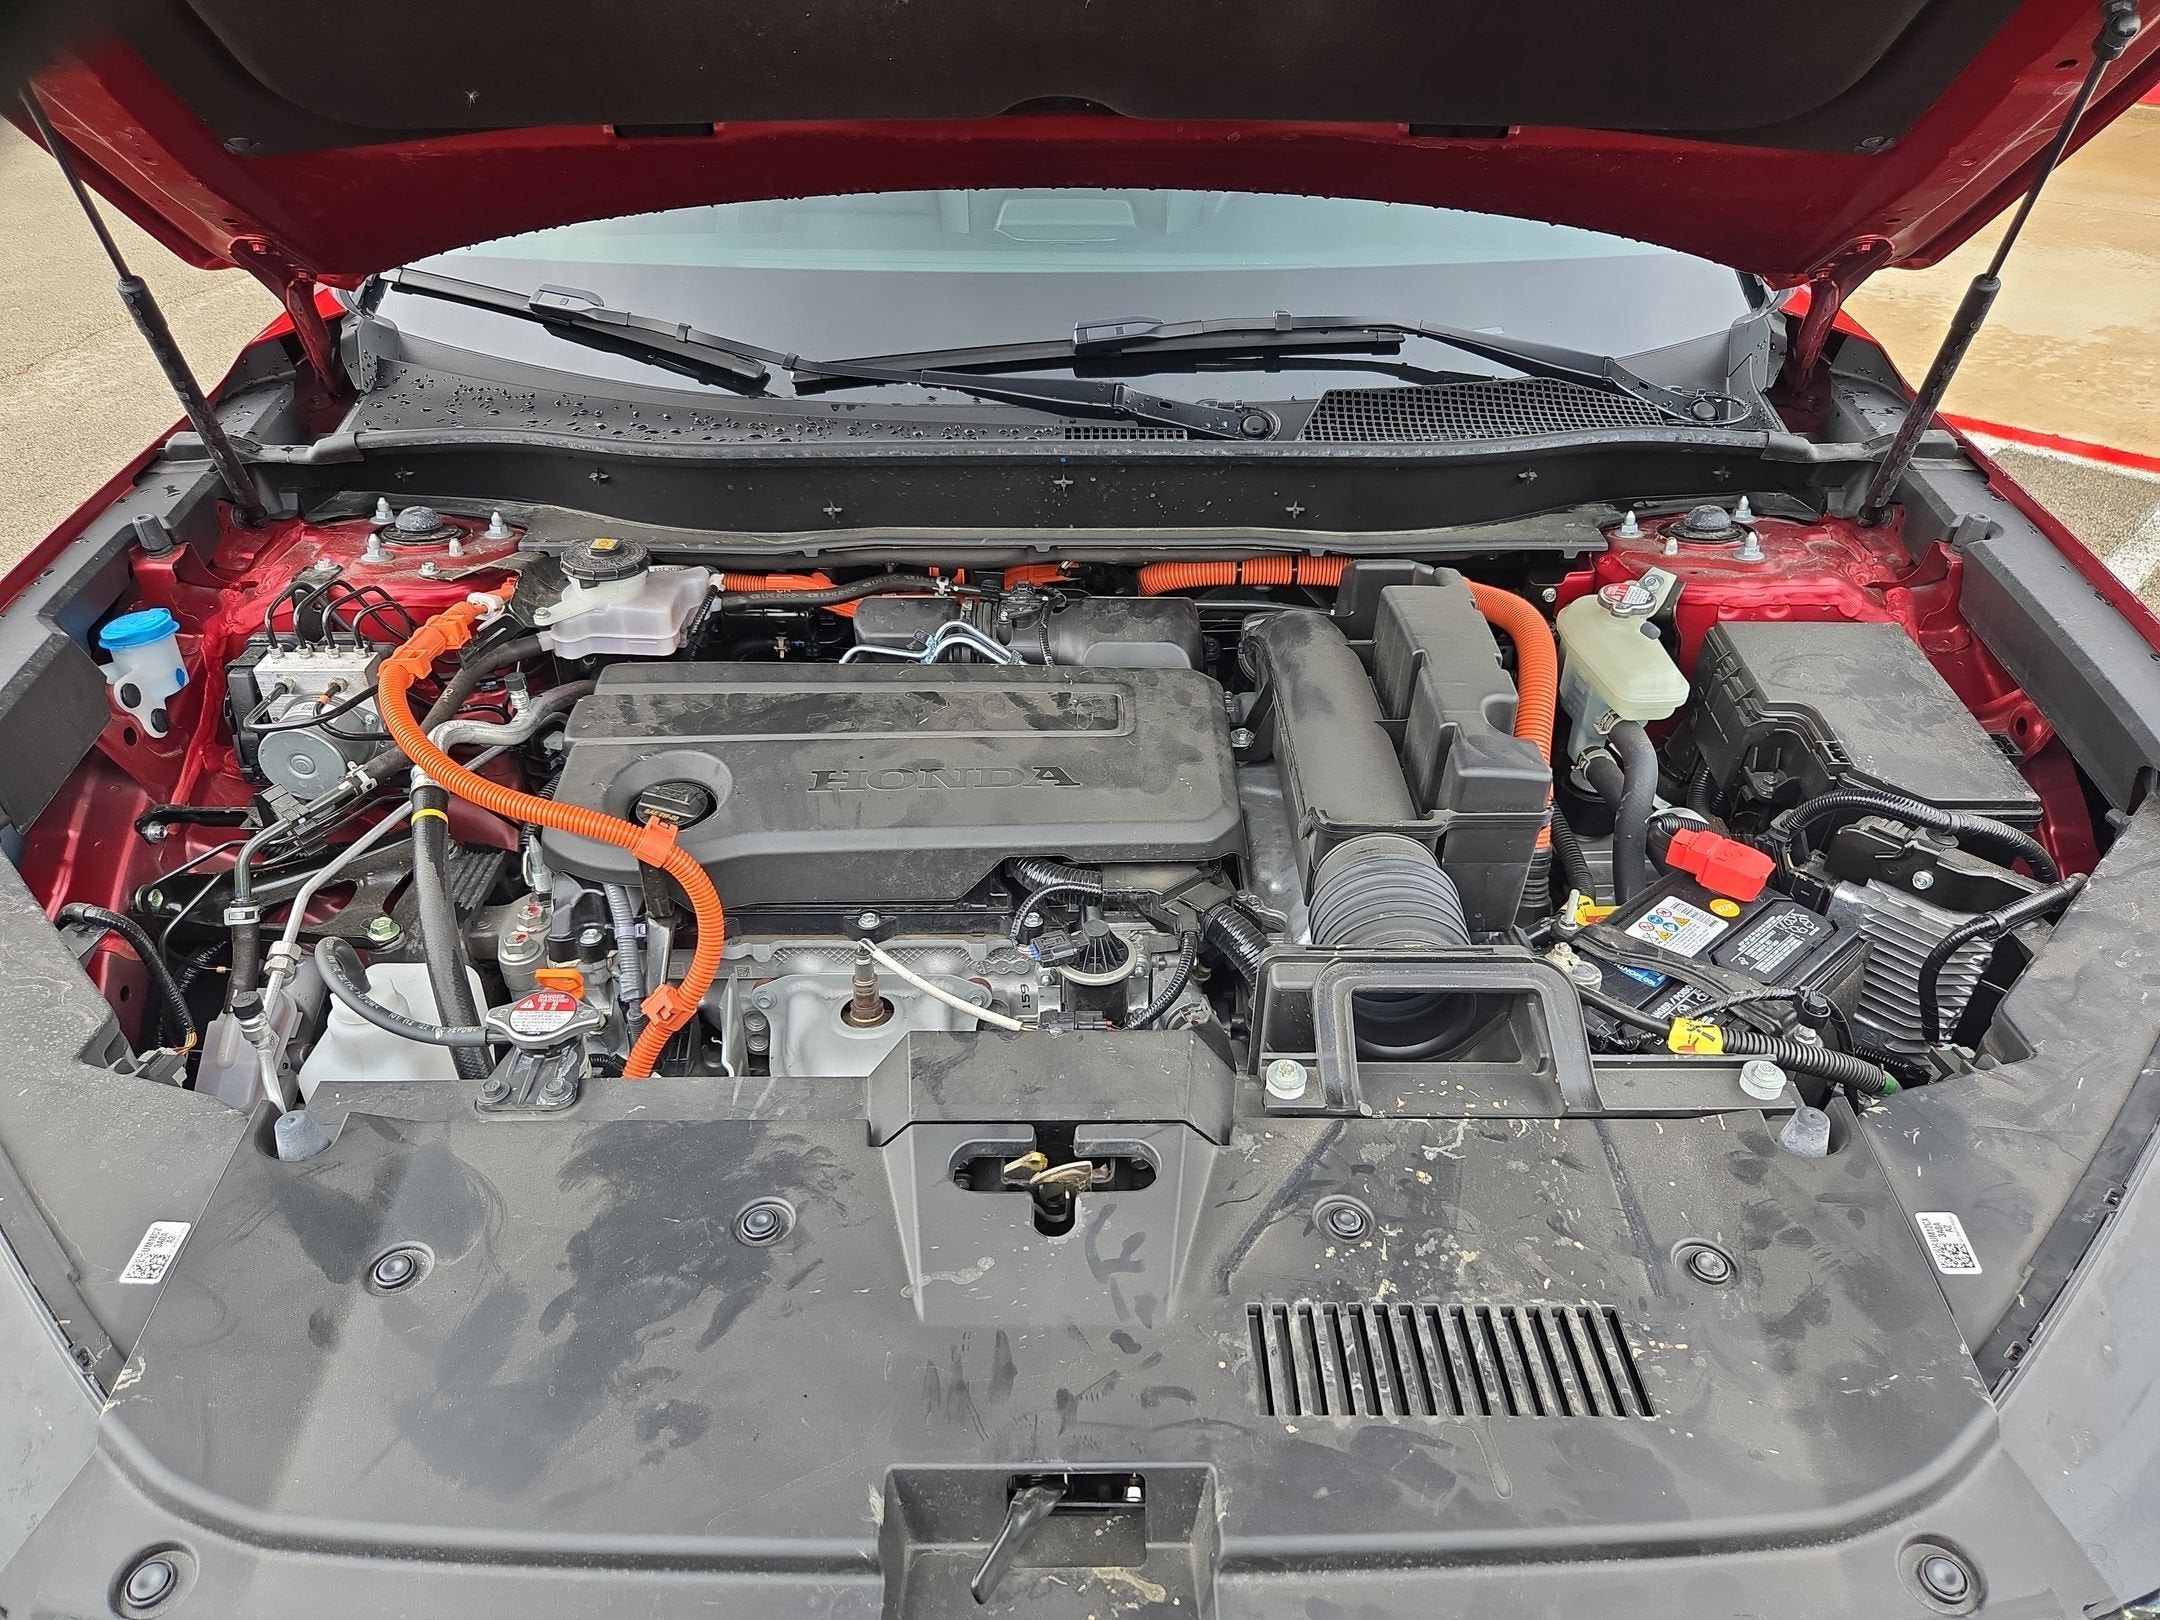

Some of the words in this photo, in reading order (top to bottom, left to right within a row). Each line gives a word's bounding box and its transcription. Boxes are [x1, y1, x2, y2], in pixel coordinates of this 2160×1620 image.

[807, 765, 1083, 792] HONDA
[1020, 983, 1031, 1009] 159
[1650, 1001, 1673, 1018] NGER
[1672, 984, 1693, 1001] POISO
